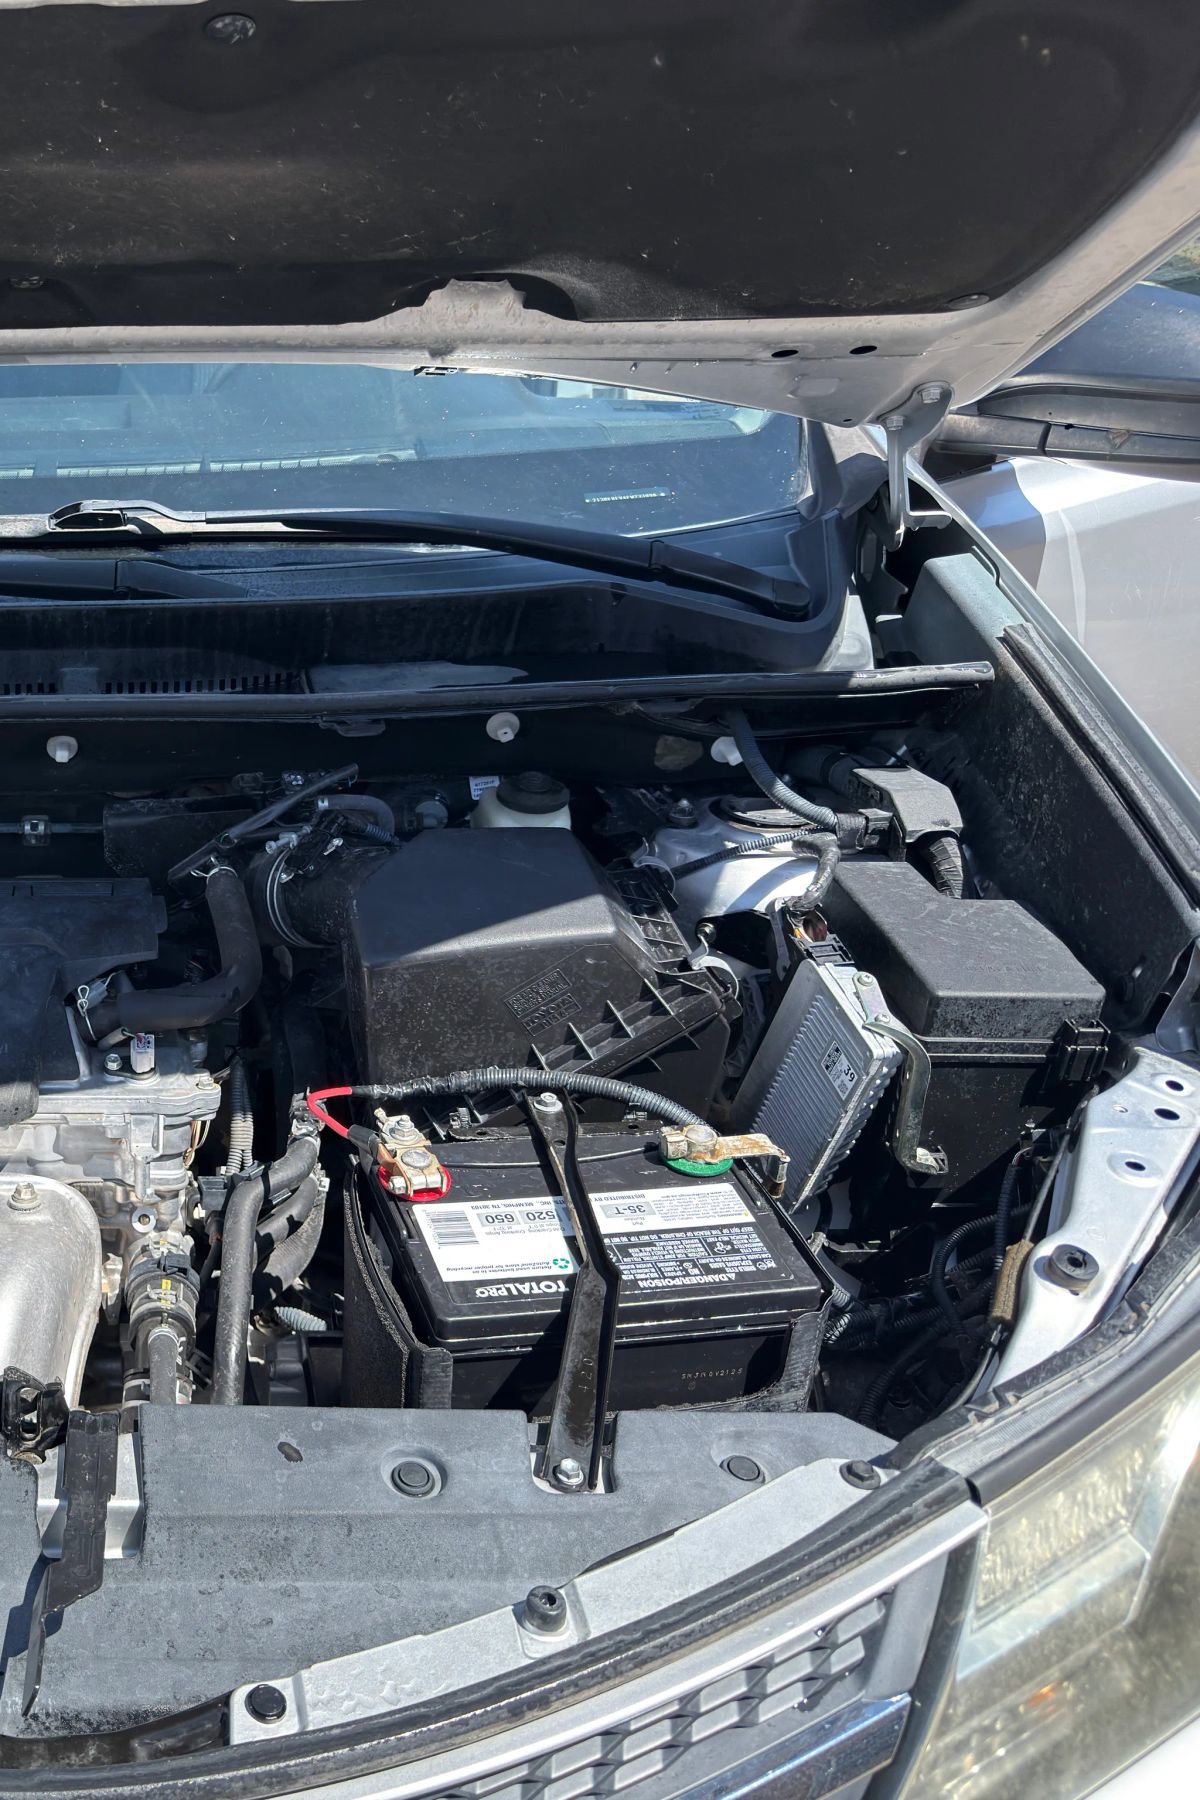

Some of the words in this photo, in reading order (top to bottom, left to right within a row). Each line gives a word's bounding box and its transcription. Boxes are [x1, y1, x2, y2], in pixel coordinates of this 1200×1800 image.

[524, 996, 574, 1027] TOYOTA
[843, 1065, 856, 1082] 39
[526, 1210, 555, 1221] 520
[613, 1205, 645, 1214] 35-T
[484, 1213, 514, 1223] 650
[637, 1274, 727, 1286] DANGER/POISON
[474, 1280, 567, 1298] TOTALPRO
